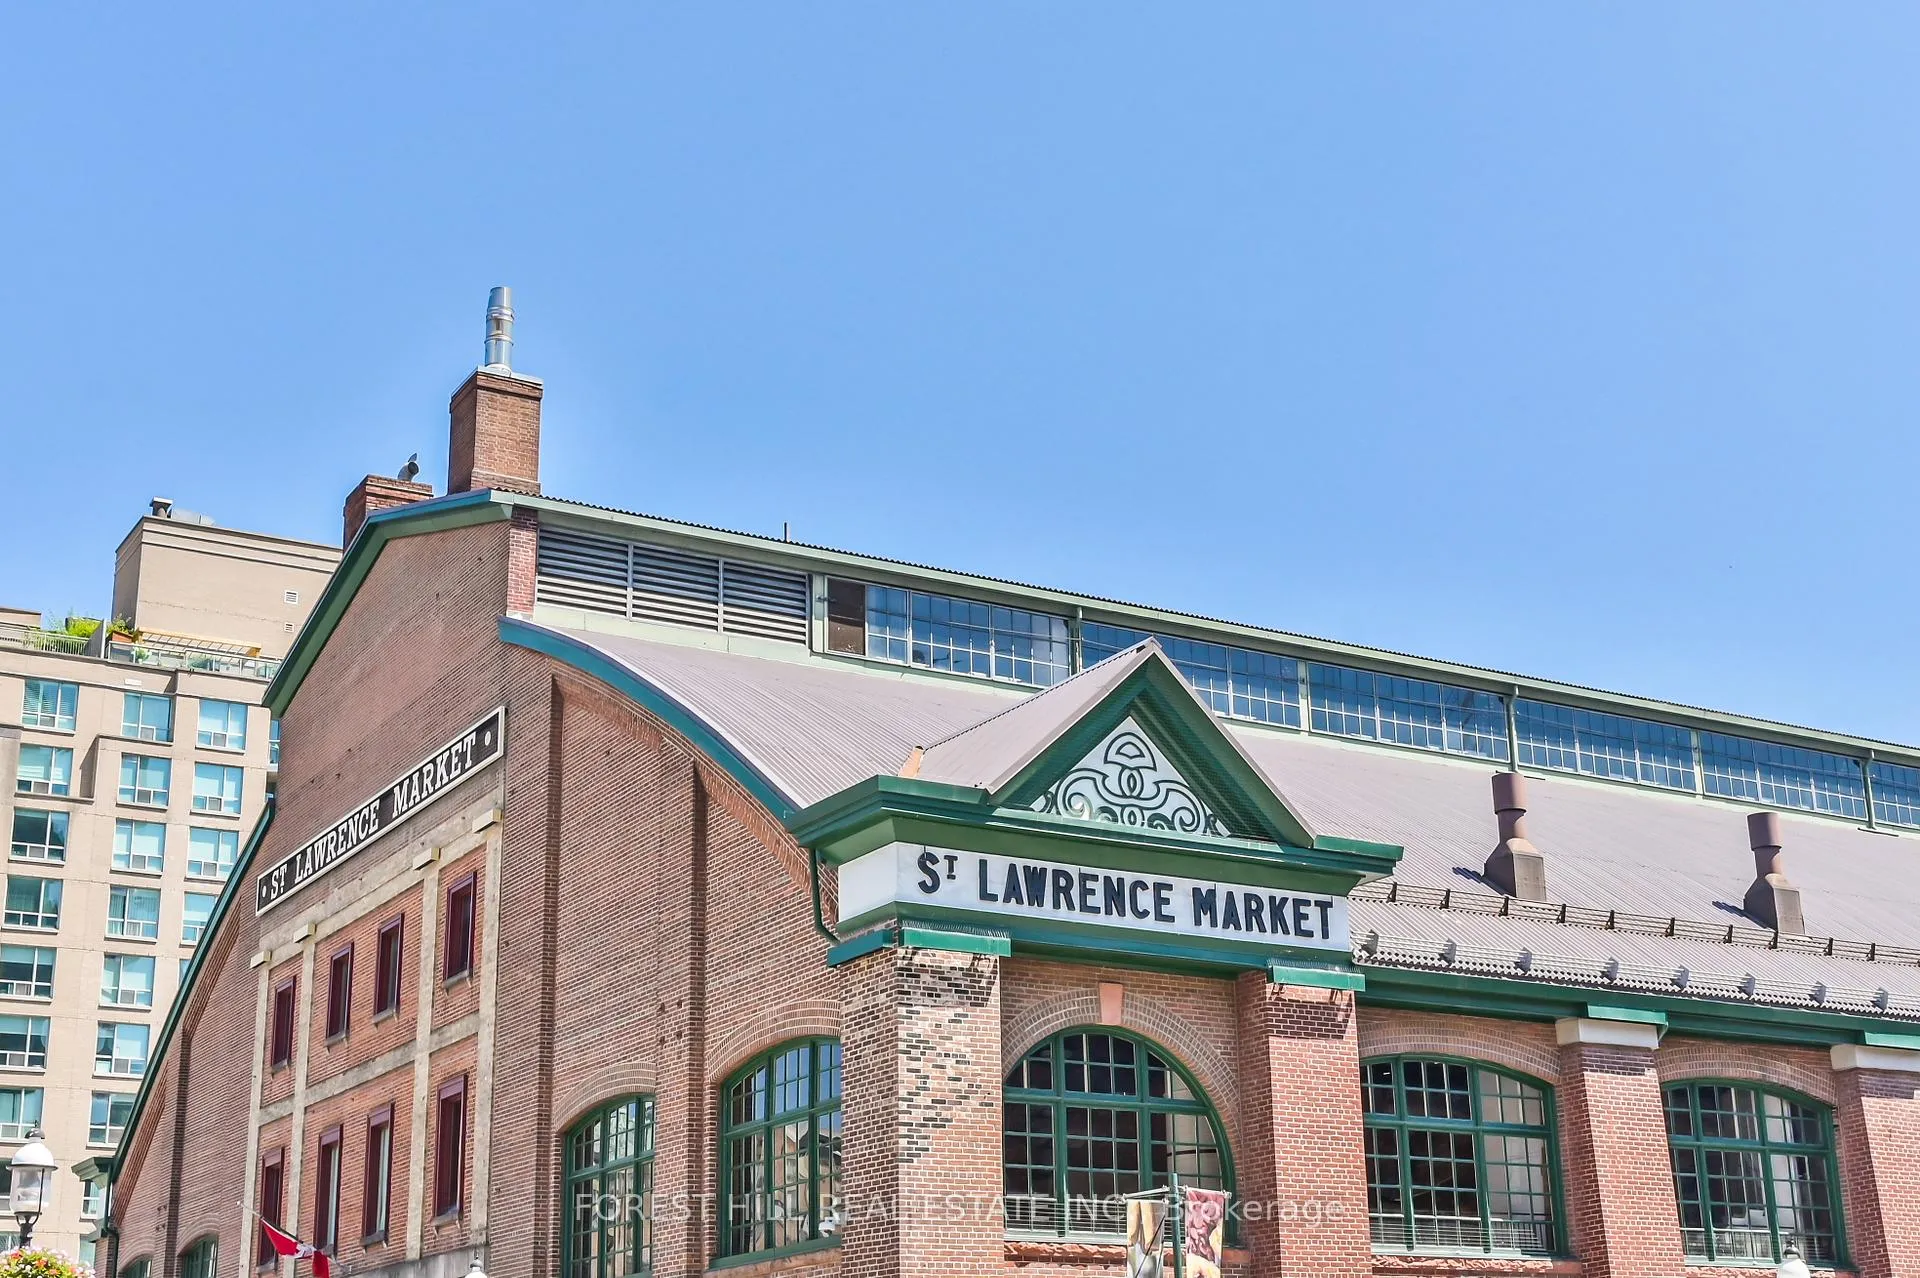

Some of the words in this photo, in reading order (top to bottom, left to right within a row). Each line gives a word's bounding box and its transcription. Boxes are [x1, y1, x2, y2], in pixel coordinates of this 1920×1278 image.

[271, 867, 287, 900] ST
[294, 798, 380, 884] LAWRENCE
[392, 732, 476, 819] MARKET
[978, 858, 1175, 924] LAWRENCE
[1192, 886, 1334, 940] MARKET
